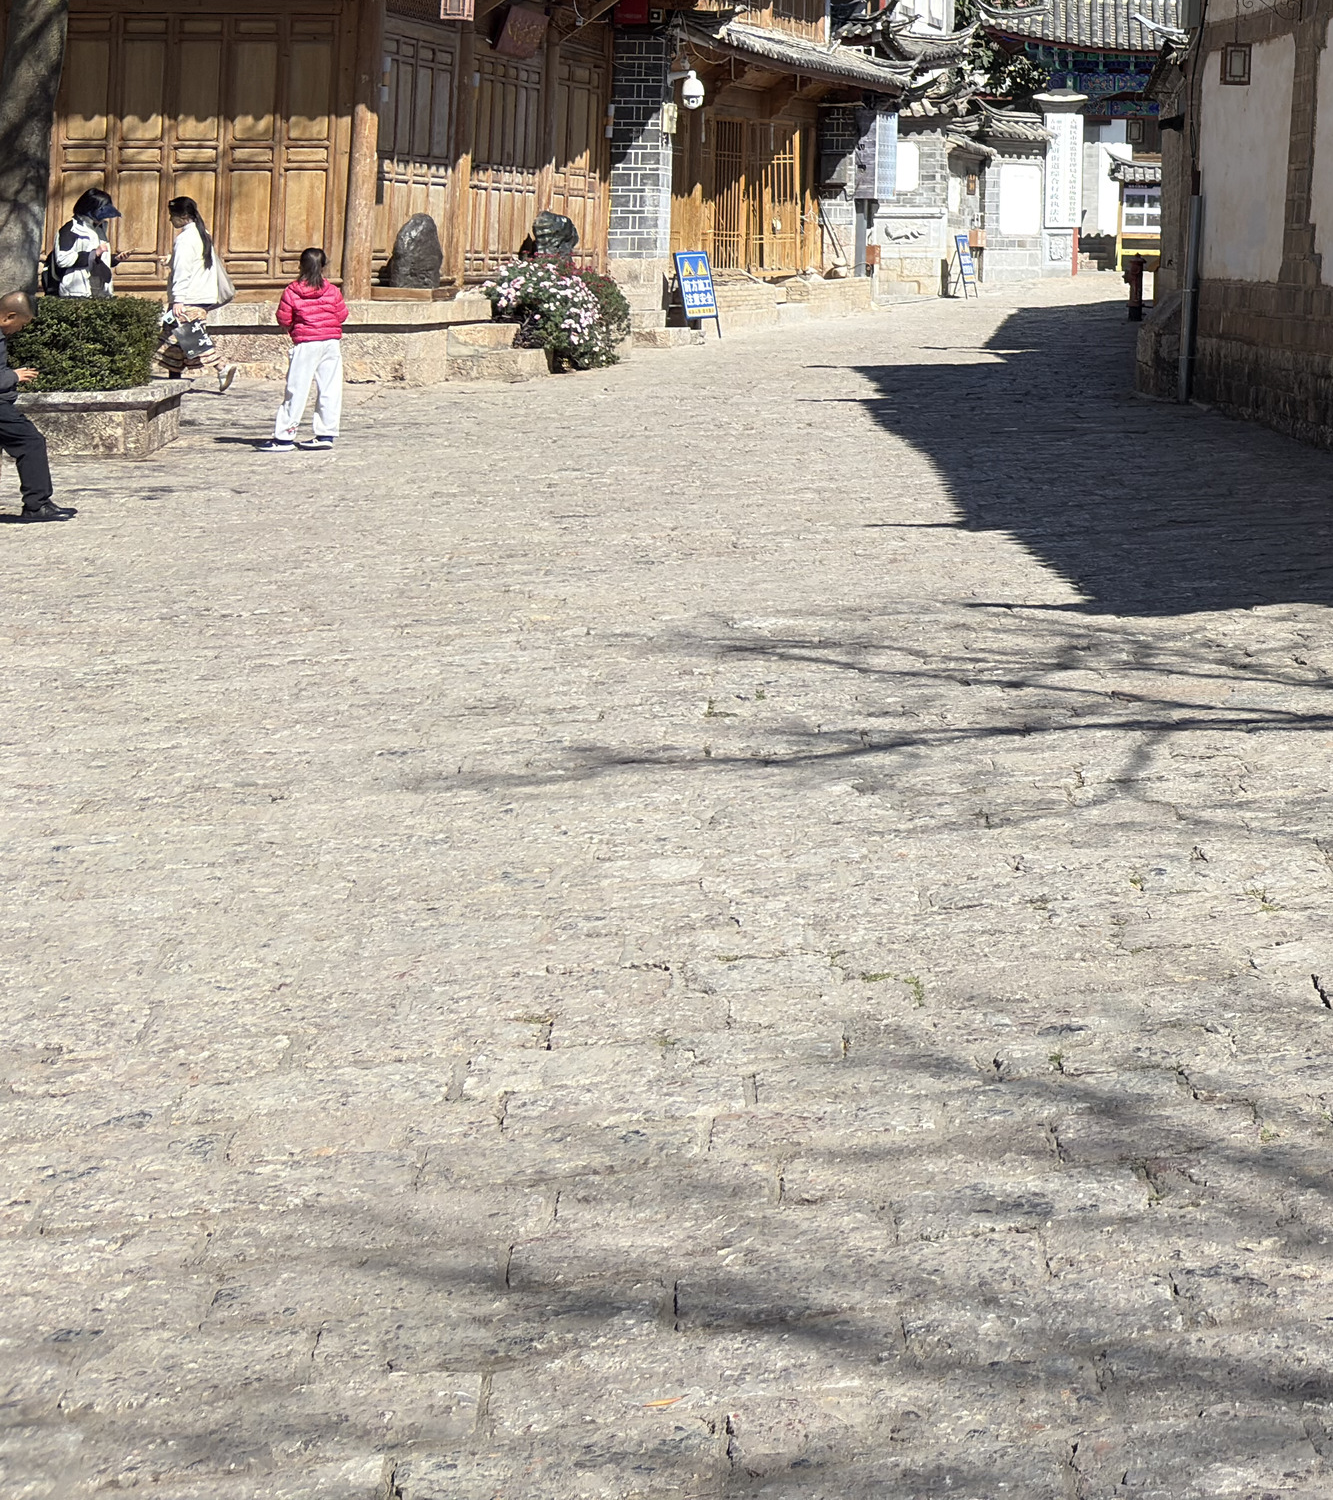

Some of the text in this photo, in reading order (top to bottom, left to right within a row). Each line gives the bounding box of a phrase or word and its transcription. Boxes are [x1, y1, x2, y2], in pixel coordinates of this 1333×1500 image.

[683, 279, 711, 293] 前方施工
[686, 292, 714, 305] 注意安全
